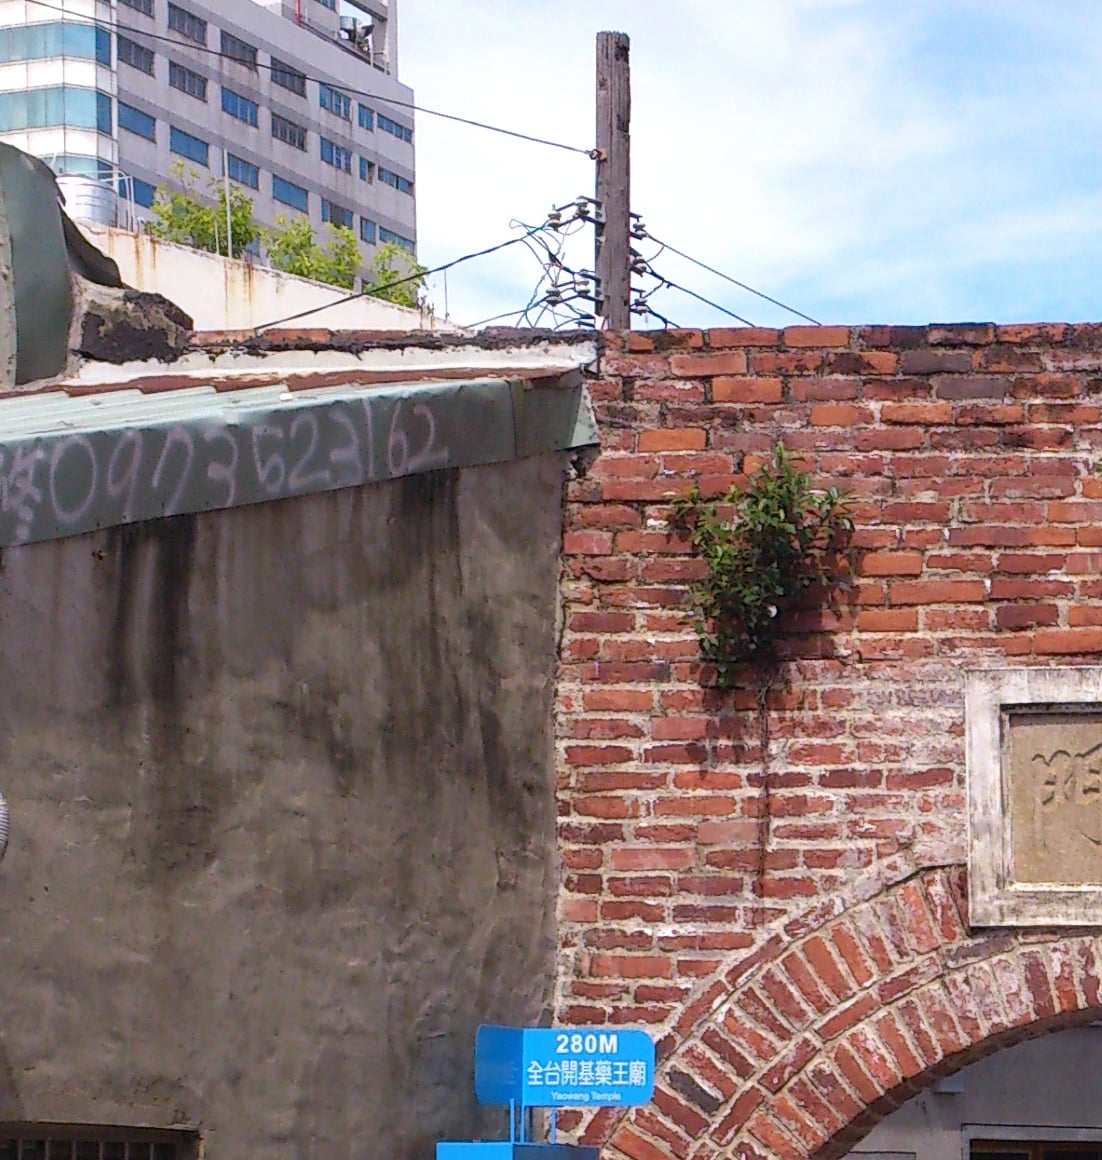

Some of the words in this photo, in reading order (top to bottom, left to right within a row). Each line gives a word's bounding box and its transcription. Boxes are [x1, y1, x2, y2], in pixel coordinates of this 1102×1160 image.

[556, 1034, 618, 1054] 280M
[527, 1060, 647, 1086] 全台開基藥王廟
[551, 1091, 590, 1102] Yaowang
[592, 1091, 622, 1101] Temple
